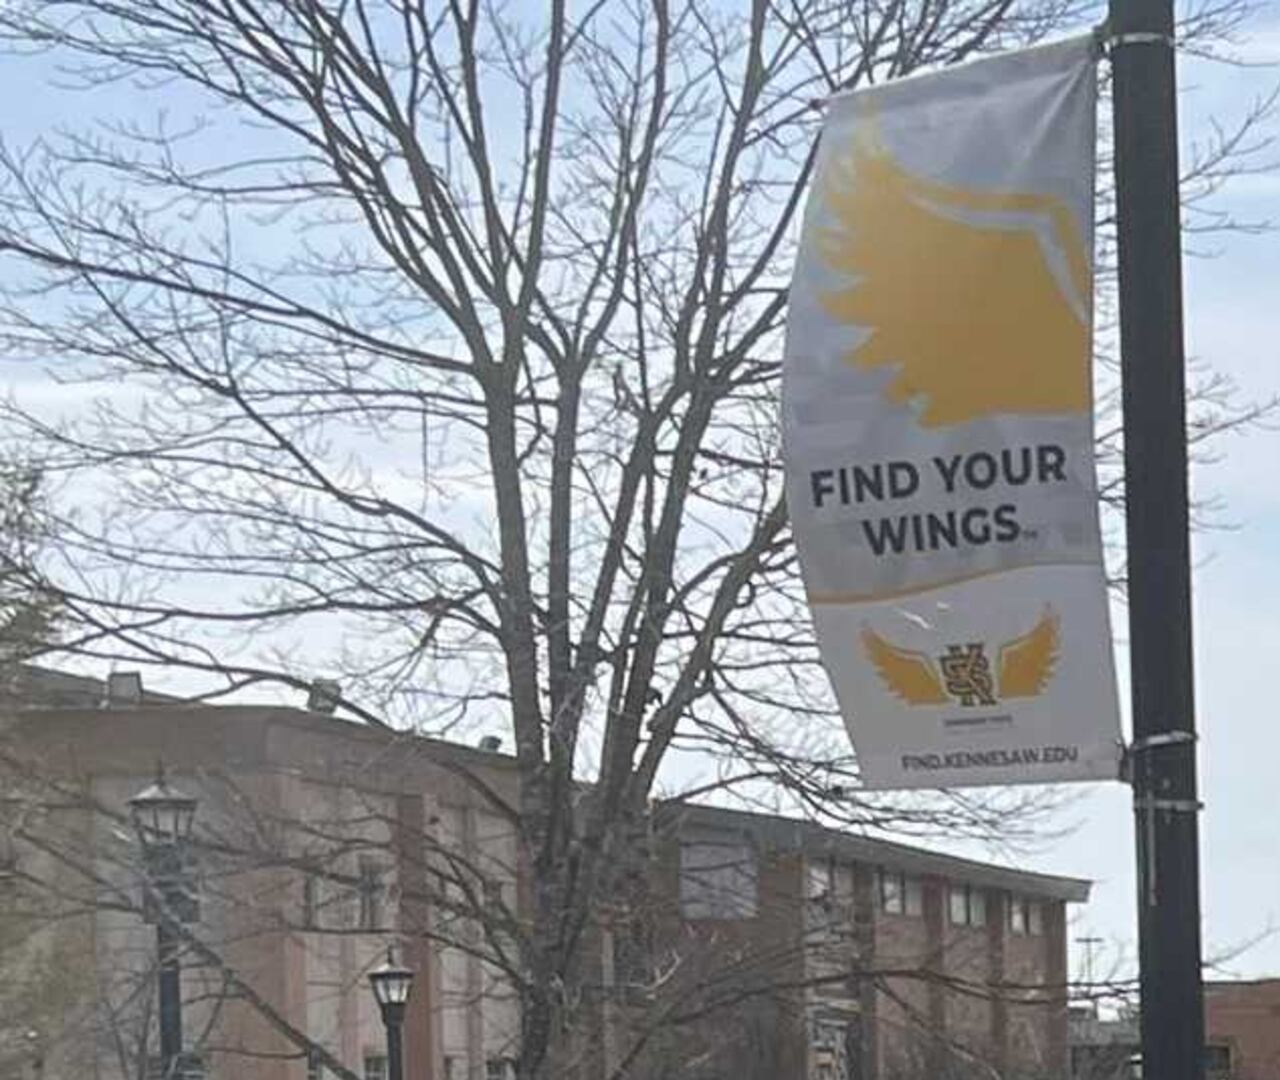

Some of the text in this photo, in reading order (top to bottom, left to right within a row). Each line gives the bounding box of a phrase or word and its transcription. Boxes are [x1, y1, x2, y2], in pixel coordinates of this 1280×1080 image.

[810, 444, 1067, 508] FIND YOUR
[900, 746, 1079, 771] FIND.KENNESAW.EDU
